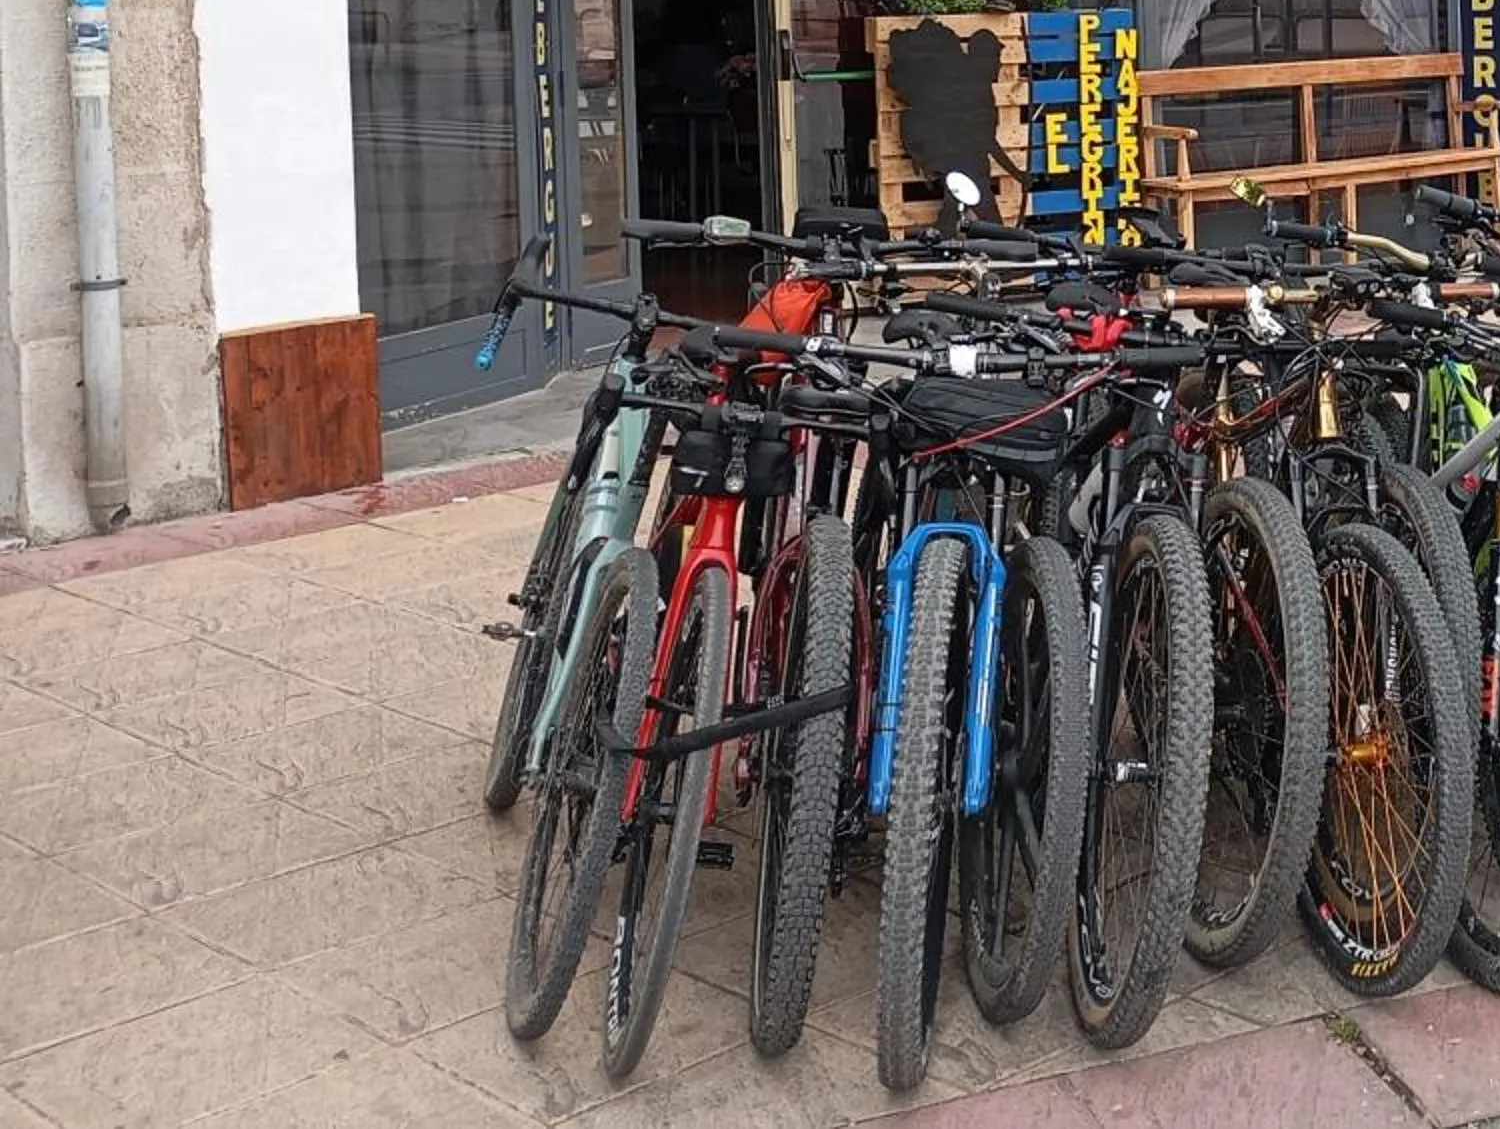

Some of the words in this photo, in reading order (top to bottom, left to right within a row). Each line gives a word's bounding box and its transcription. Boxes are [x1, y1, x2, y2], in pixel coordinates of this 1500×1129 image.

[1045, 112, 1070, 174] EL
[1078, 14, 1106, 247] PEREGRIN
[1115, 28, 1143, 248] NAJERIO
